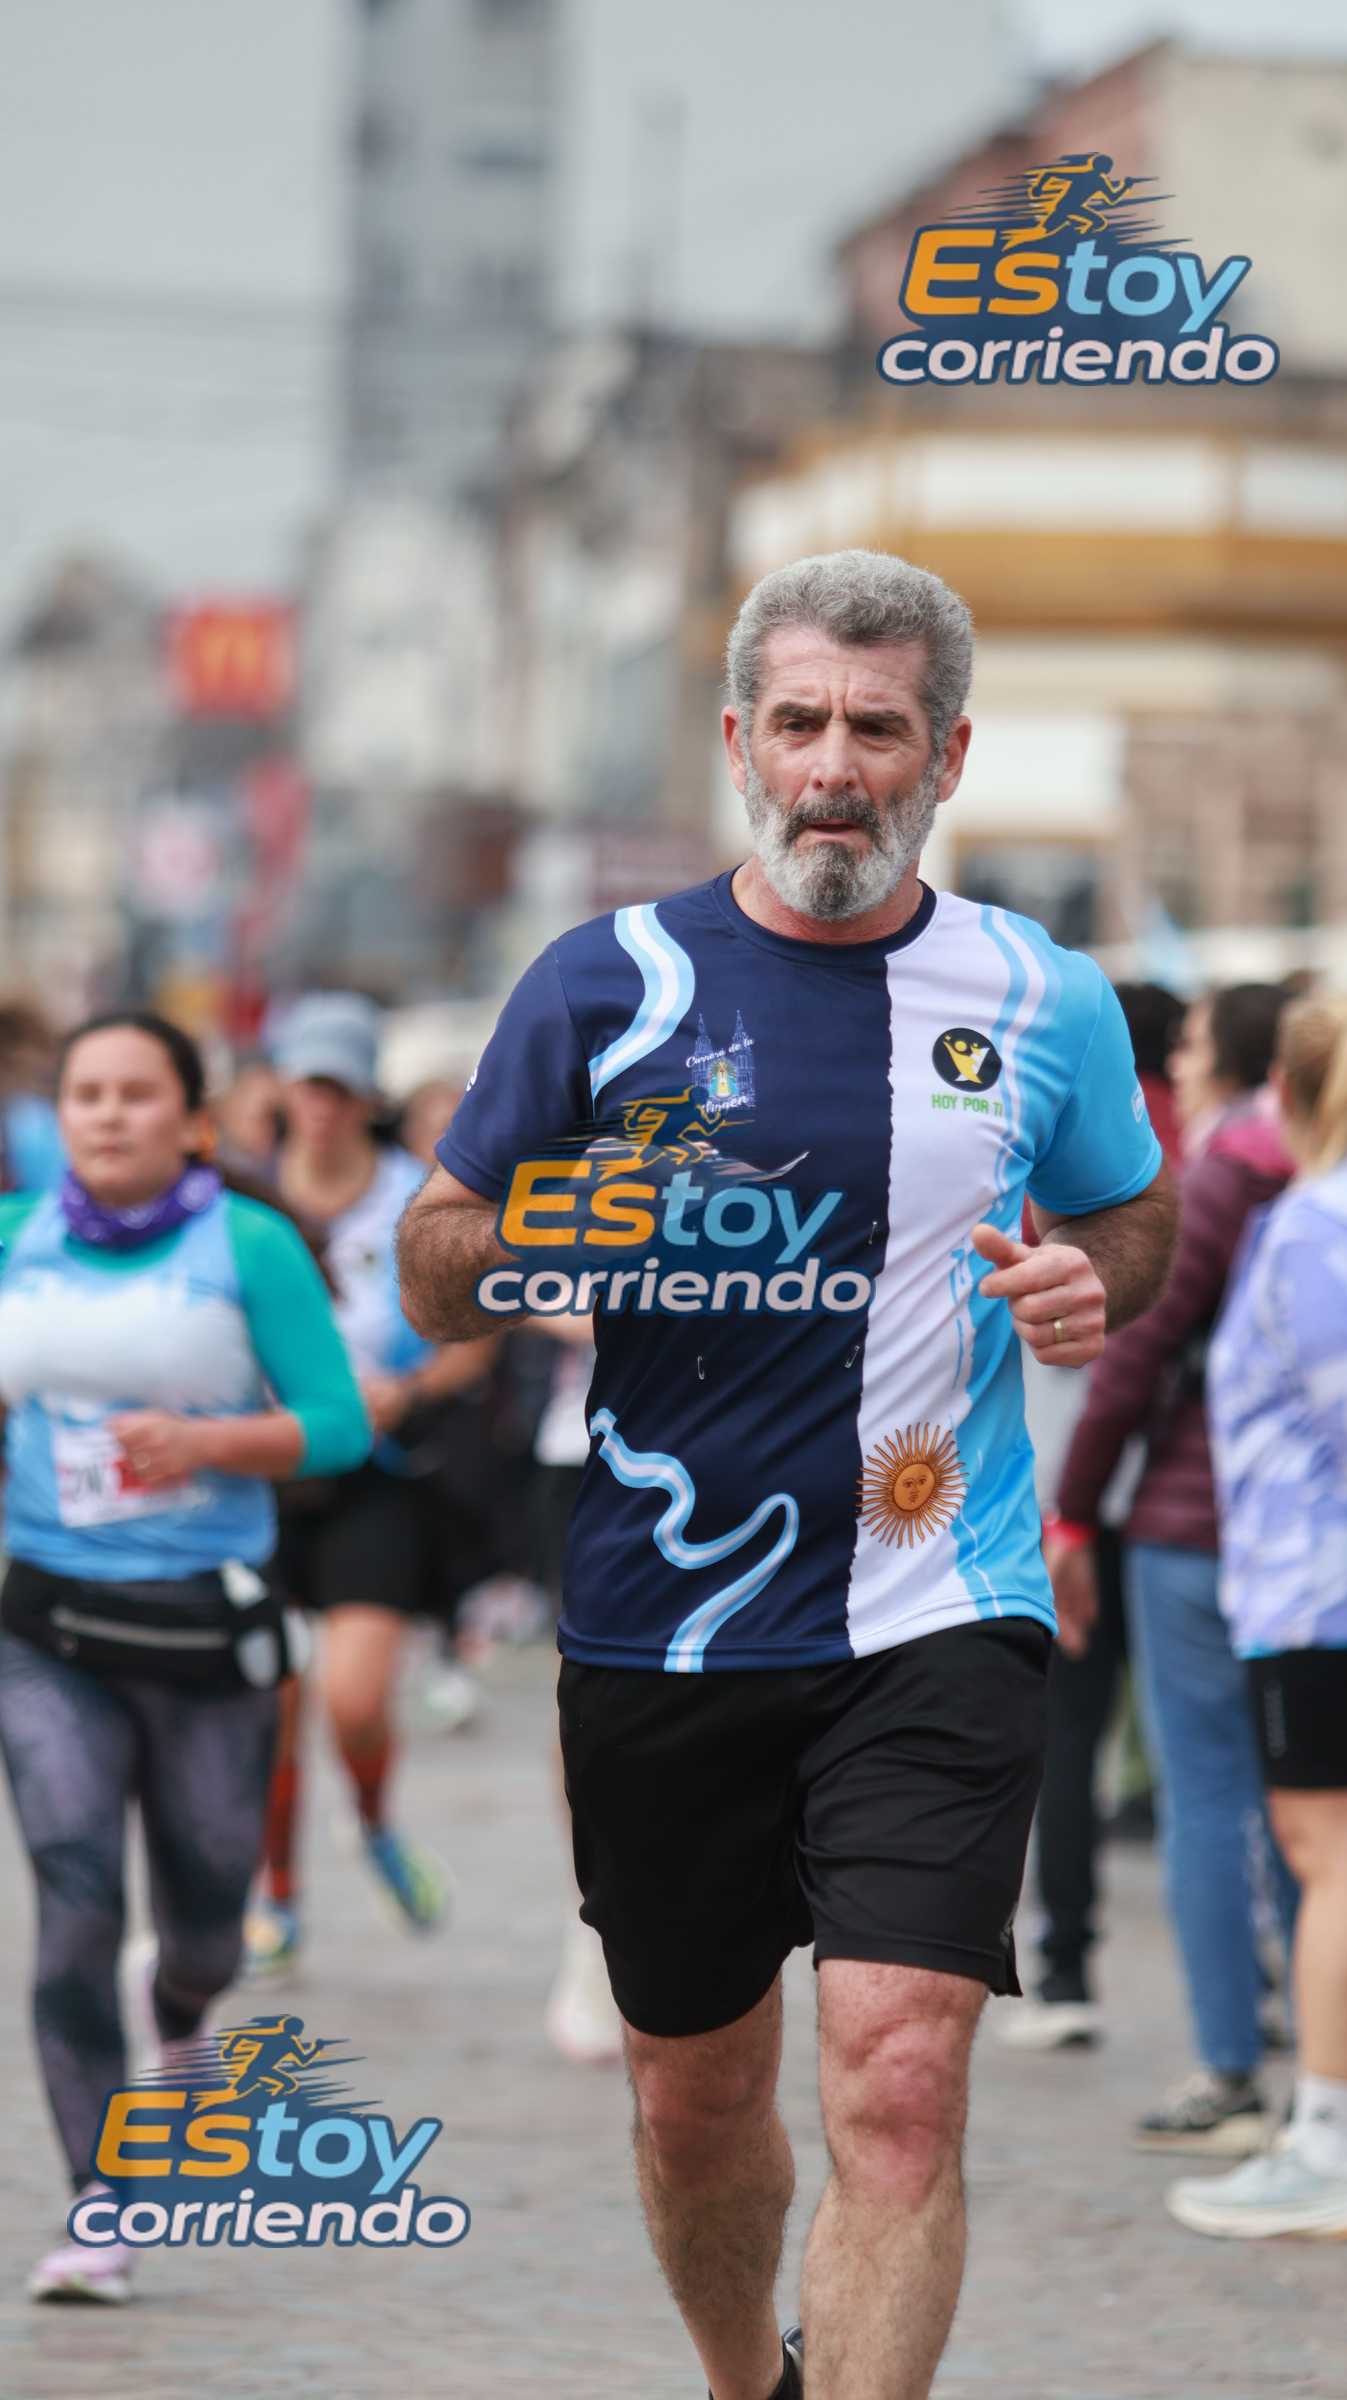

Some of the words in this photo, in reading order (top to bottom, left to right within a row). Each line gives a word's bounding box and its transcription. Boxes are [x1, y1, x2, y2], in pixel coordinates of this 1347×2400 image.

[728, 1043, 741, 1053] de
[931, 1094, 957, 1109] HOY
[963, 1097, 989, 1114] POR
[993, 1102, 1004, 1117] TI
